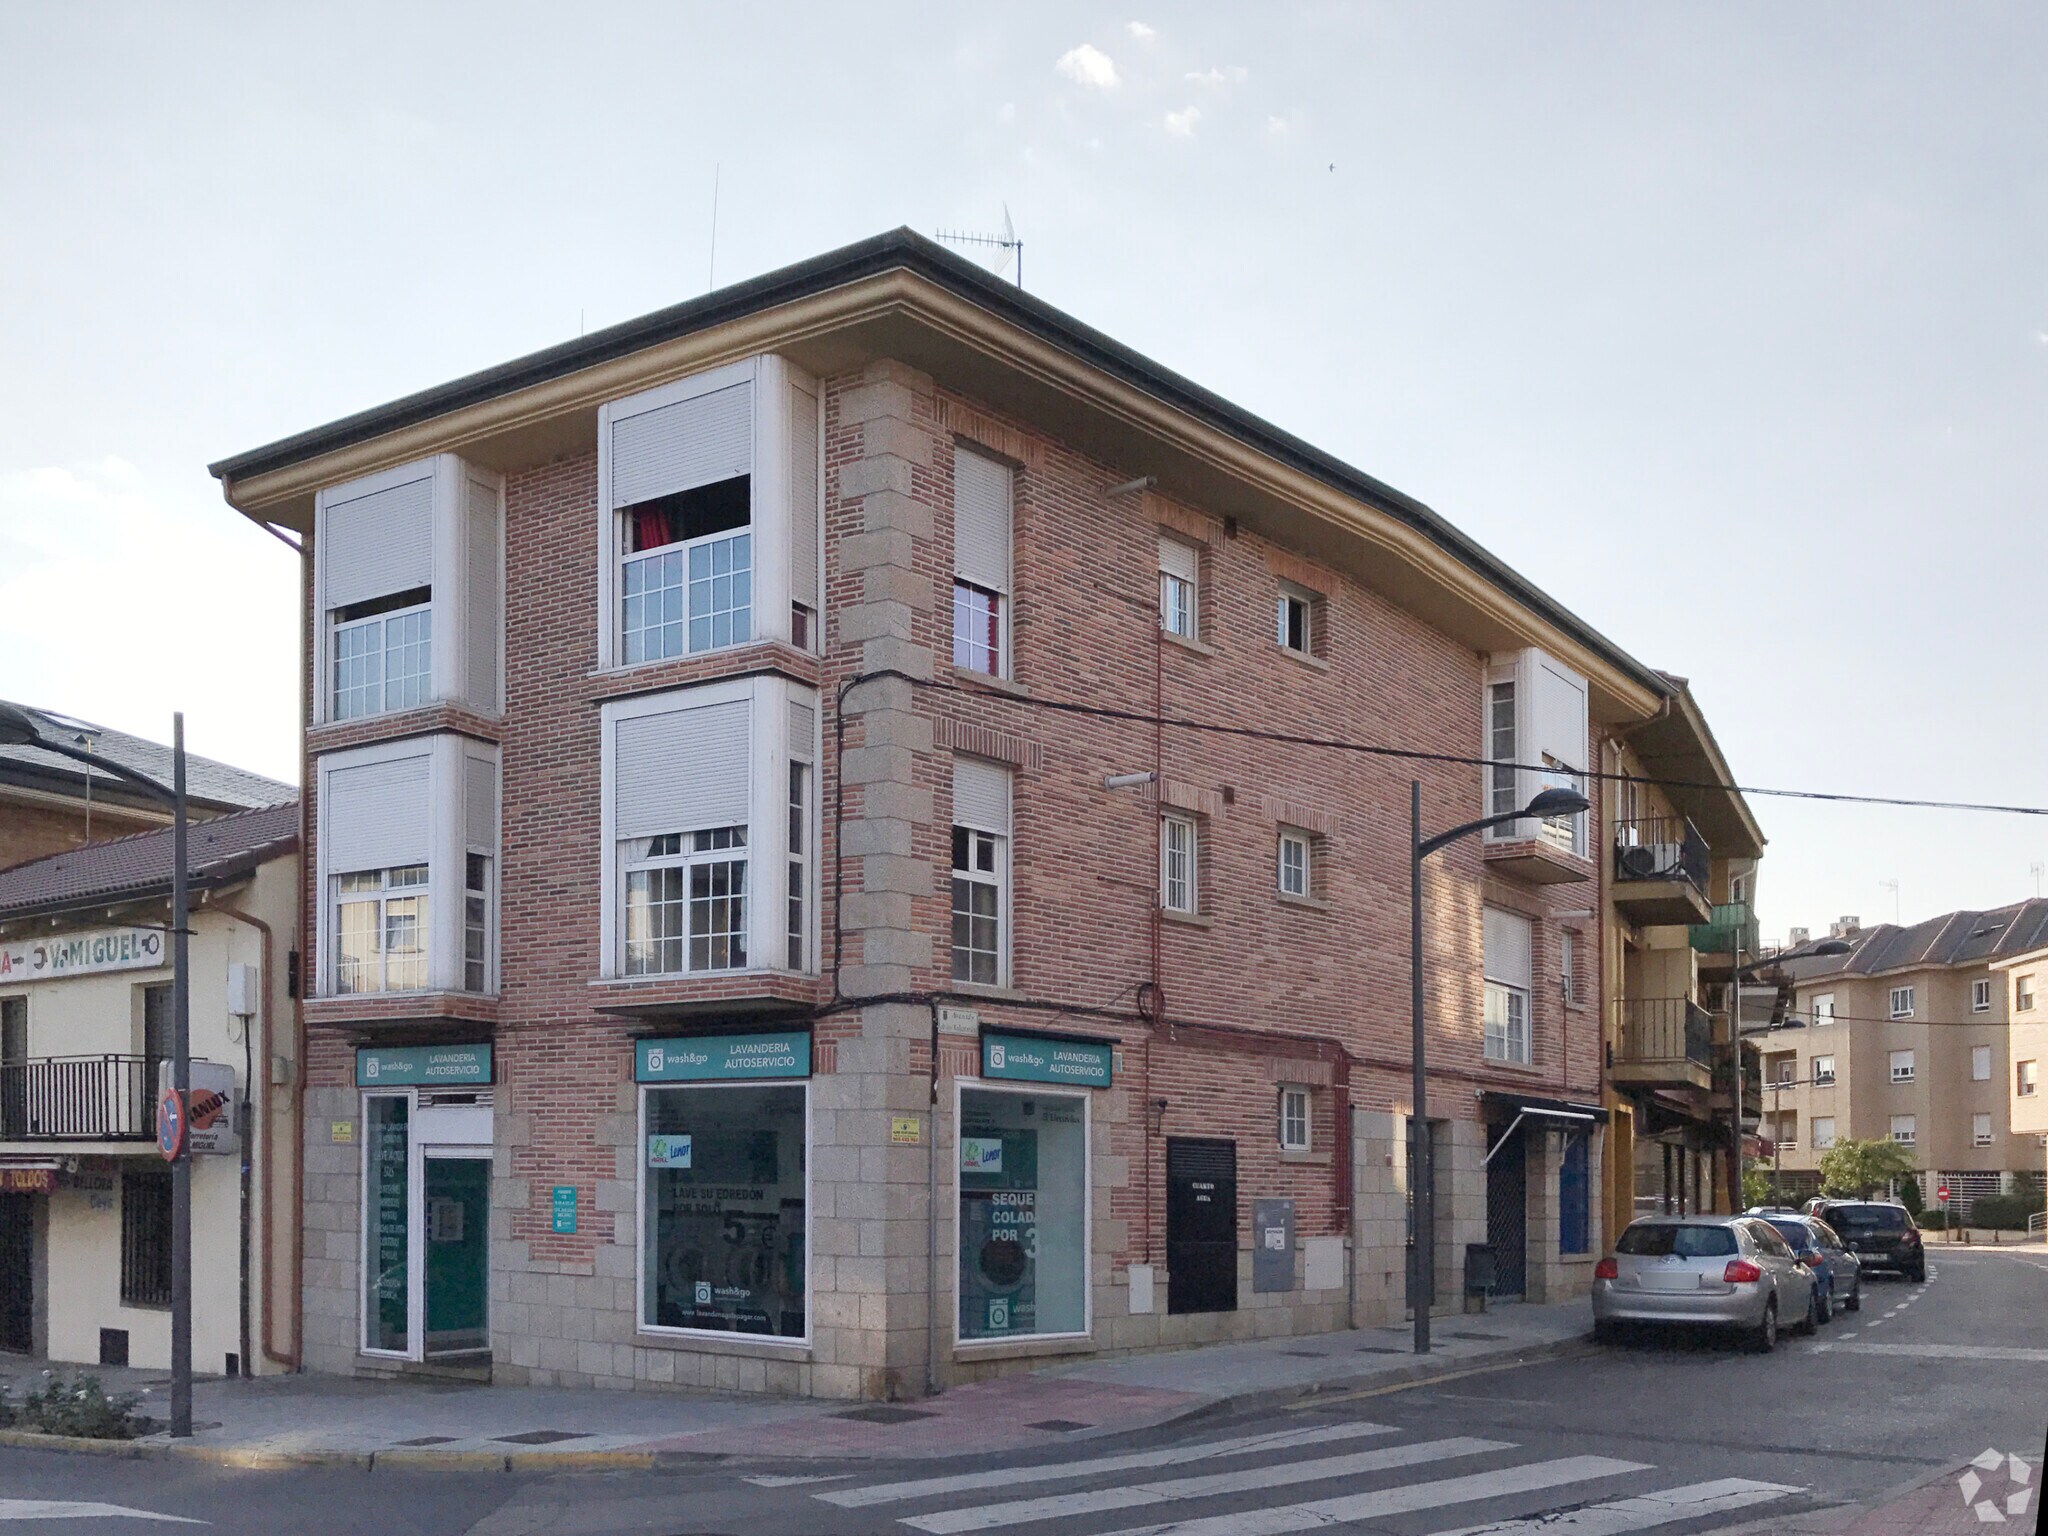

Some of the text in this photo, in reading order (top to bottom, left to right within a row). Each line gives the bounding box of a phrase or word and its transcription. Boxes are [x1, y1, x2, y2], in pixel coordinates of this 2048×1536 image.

[69, 933, 141, 966] MIGUEL
[730, 1043, 790, 1055] LAVANDERIA
[429, 1053, 476, 1064] LAVANDERIA
[666, 1053, 708, 1065] wash&go
[724, 1056, 795, 1069] AUTOSERVICIO
[1008, 1053, 1044, 1066] wash&go
[1053, 1051, 1101, 1063] LAVANDERIA
[381, 1061, 413, 1072] wash&go
[425, 1065, 480, 1076] AUTOSERVICIO
[1049, 1064, 1104, 1077] AUTOSERVICIO
[10, 1169, 49, 1189] TOLDOS
[673, 1187, 697, 1199] LAVE
[701, 1187, 714, 1199] SU
[992, 1193, 1034, 1206] SEQUE
[723, 1210, 746, 1245] 5
[992, 1228, 1041, 1259] POR 3
[714, 1286, 751, 1298] wash&go
[1012, 1301, 1036, 1313] wash
